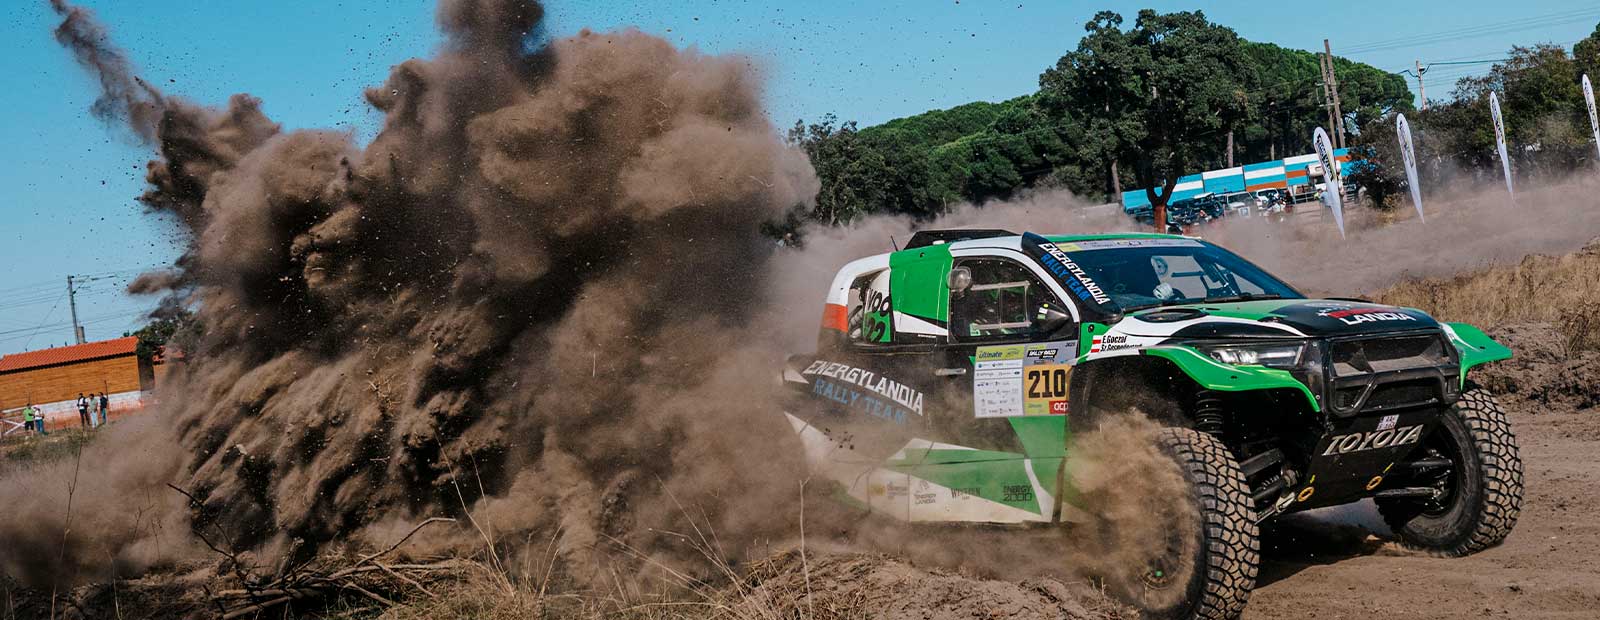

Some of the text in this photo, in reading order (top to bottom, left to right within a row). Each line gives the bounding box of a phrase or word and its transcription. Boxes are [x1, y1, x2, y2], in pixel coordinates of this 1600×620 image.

[1038, 242, 1111, 304] ENERGYLANDIA
[1040, 253, 1092, 301] RALLY TEAM
[1339, 312, 1417, 325] LANDIA
[803, 360, 924, 416] ENERGYLANDIA
[813, 378, 907, 424] RALLY TEAM
[1028, 369, 1066, 398] 210
[1054, 402, 1069, 412] acp
[1322, 424, 1425, 456] TOYOTA
